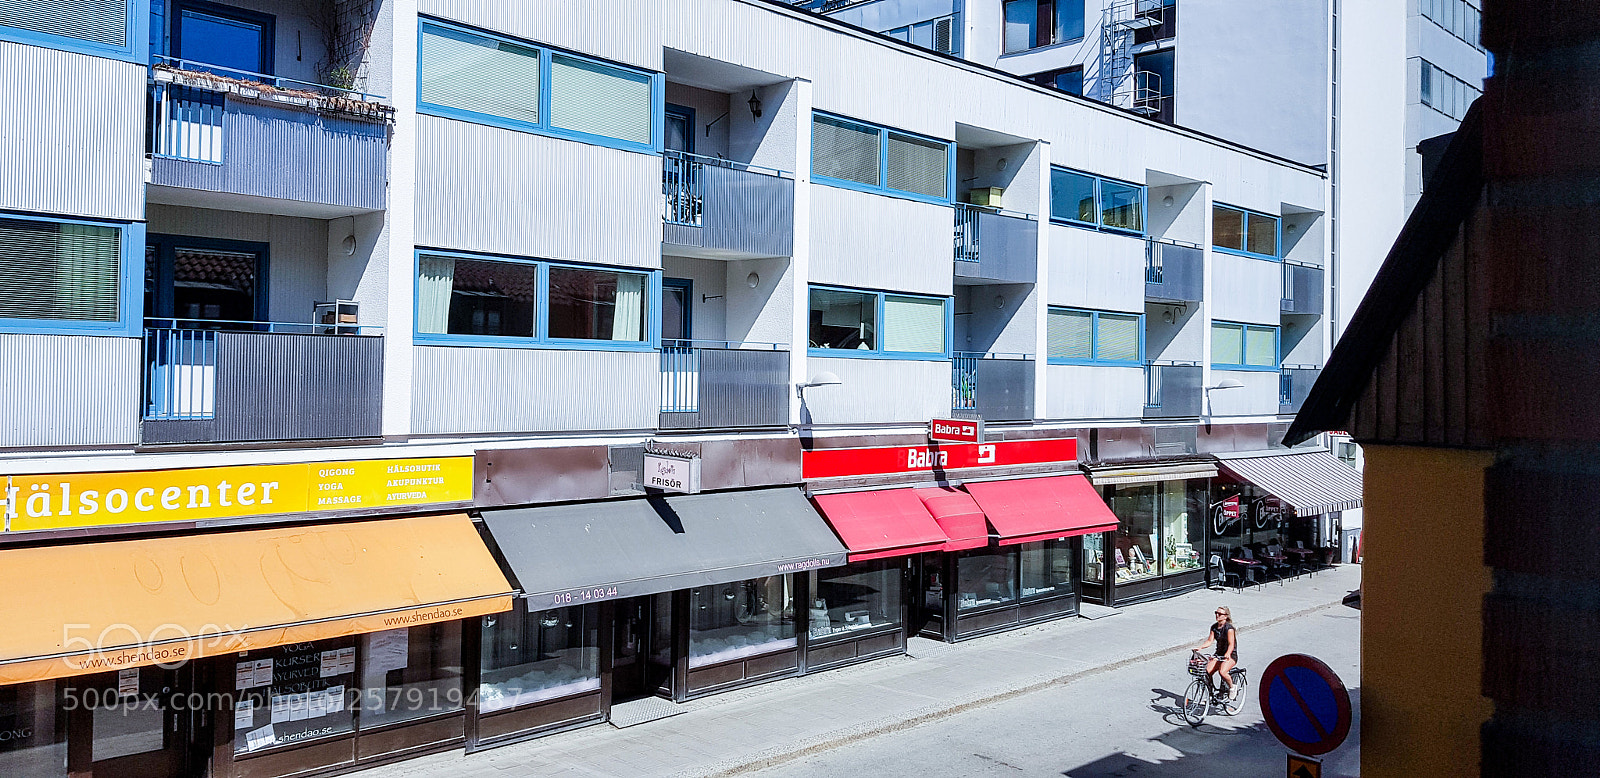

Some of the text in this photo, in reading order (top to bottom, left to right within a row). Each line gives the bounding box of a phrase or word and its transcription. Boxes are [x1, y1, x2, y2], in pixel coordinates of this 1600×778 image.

[935, 424, 960, 435] Babra
[908, 448, 948, 468] Babra
[318, 468, 355, 477] QIGONG
[387, 464, 441, 474] HÄLSOBUTIK
[318, 483, 343, 491] YOGA
[386, 477, 444, 487] AKUPUNKTUR
[652, 476, 681, 488] FRISÖR
[317, 495, 362, 505] MASSAGE
[386, 491, 427, 501] AYURVEDA
[778, 558, 830, 571] www.ragdolls.nu
[554, 593, 572, 604] 018
[581, 590, 591, 600] 14
[593, 588, 605, 599] 03
[607, 586, 618, 597] 44
[384, 607, 463, 627] www.shendao.se
[282, 642, 315, 654] YOGA
[79, 647, 185, 669] www.shendao.se
[275, 653, 320, 668] KURSER
